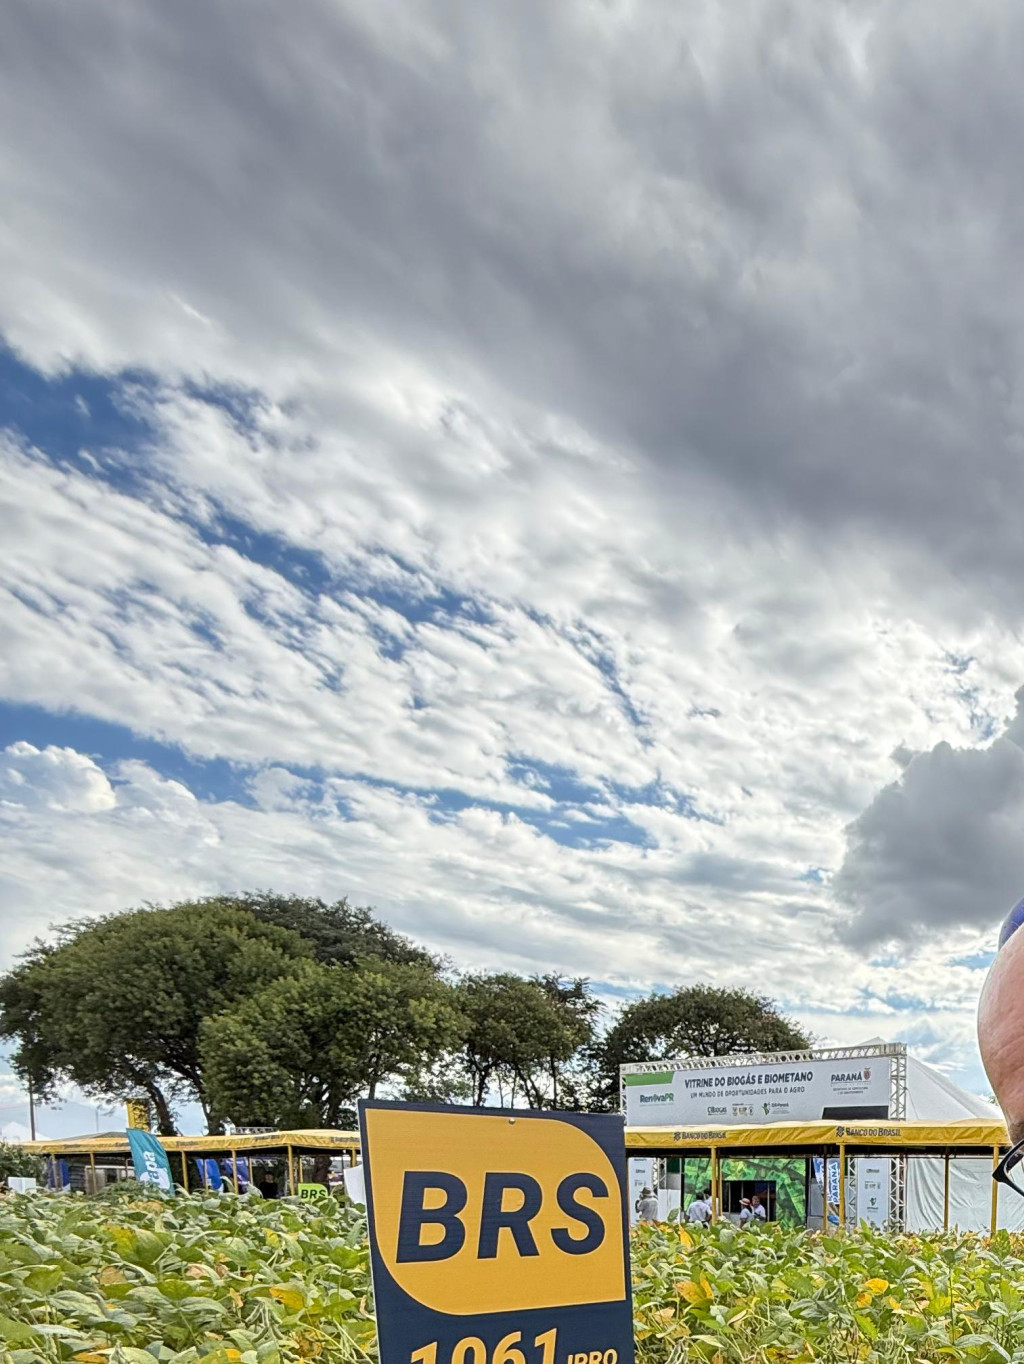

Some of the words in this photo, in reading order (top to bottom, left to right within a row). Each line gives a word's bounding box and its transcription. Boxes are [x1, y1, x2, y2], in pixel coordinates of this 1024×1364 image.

[685, 1078, 713, 1088] VITRINE
[715, 1077, 725, 1087] DO
[727, 1073, 756, 1086] BIOGÁS
[758, 1075, 763, 1084] E
[765, 1071, 813, 1083] BIOMETANO
[846, 1127, 867, 1136] BANCO
[878, 1127, 901, 1136] BRASIL
[301, 1189, 327, 1199] BRS
[396, 1171, 609, 1263] BRS
